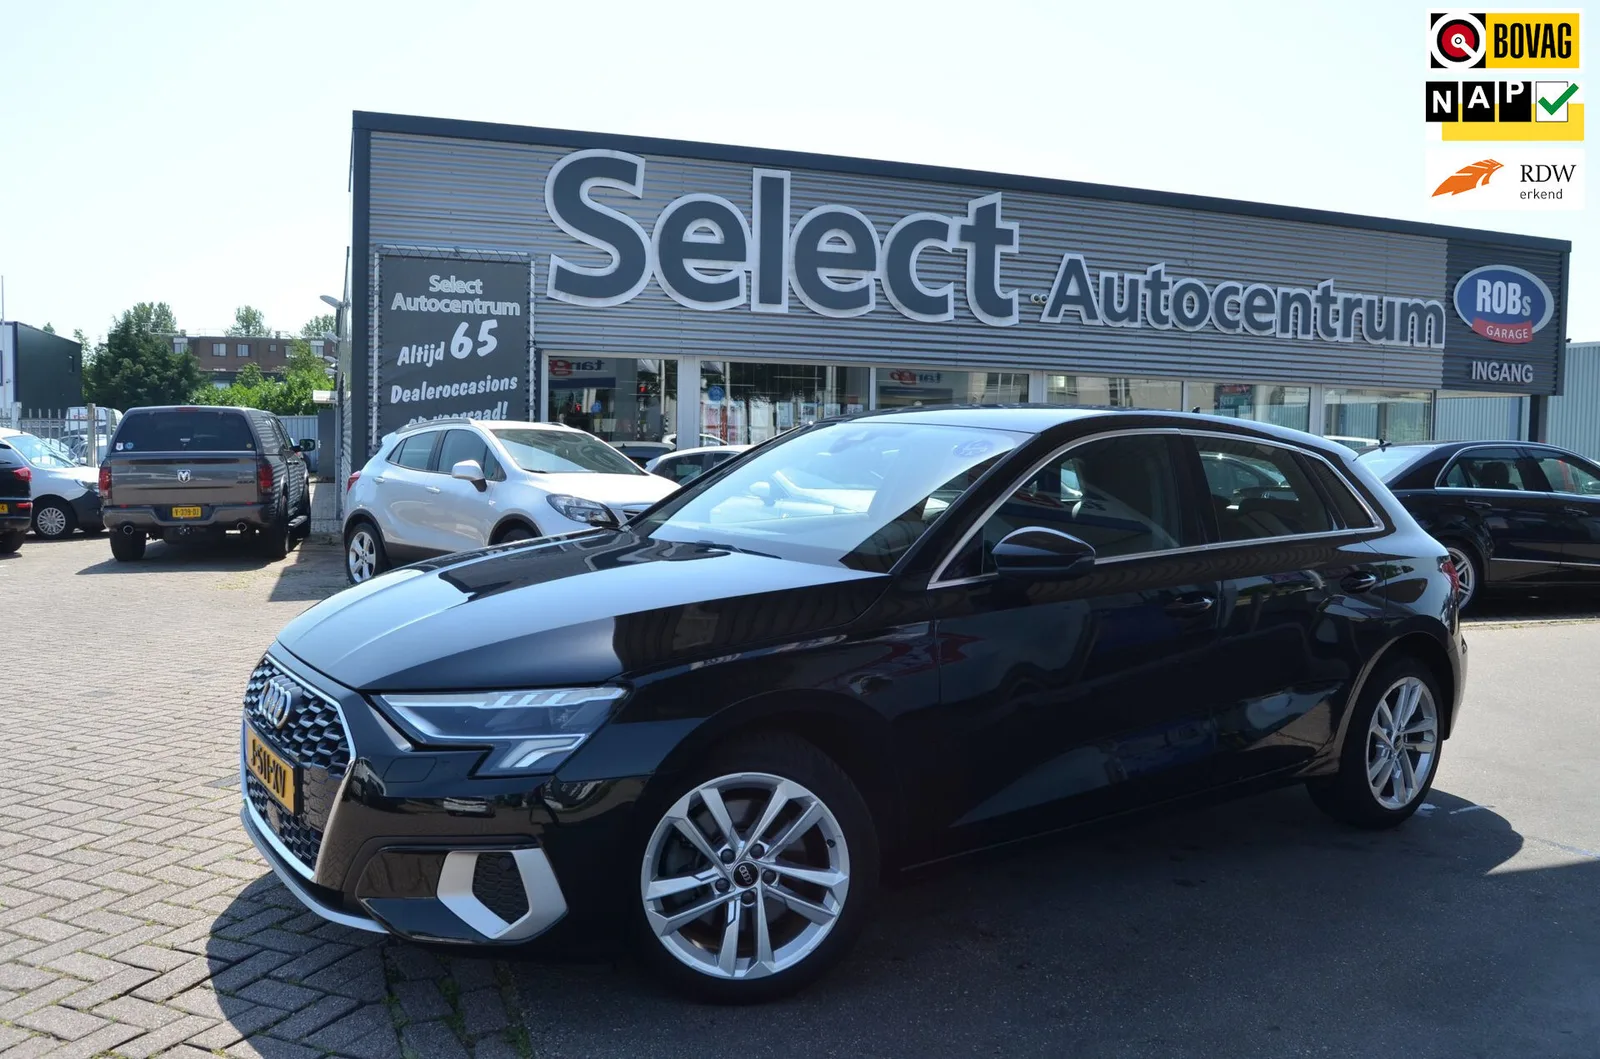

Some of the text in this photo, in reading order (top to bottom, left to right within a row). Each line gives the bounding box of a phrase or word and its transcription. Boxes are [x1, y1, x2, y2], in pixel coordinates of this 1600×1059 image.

[544, 149, 1445, 349] Select Autocentrum
[429, 275, 483, 294] Select
[391, 292, 520, 316] Autocentrum
[397, 319, 498, 367] Altijd 65
[1486, 325, 1529, 340] GARAGE
[1472, 361, 1534, 383] INGANG
[390, 375, 518, 404] Dealeroccasions
